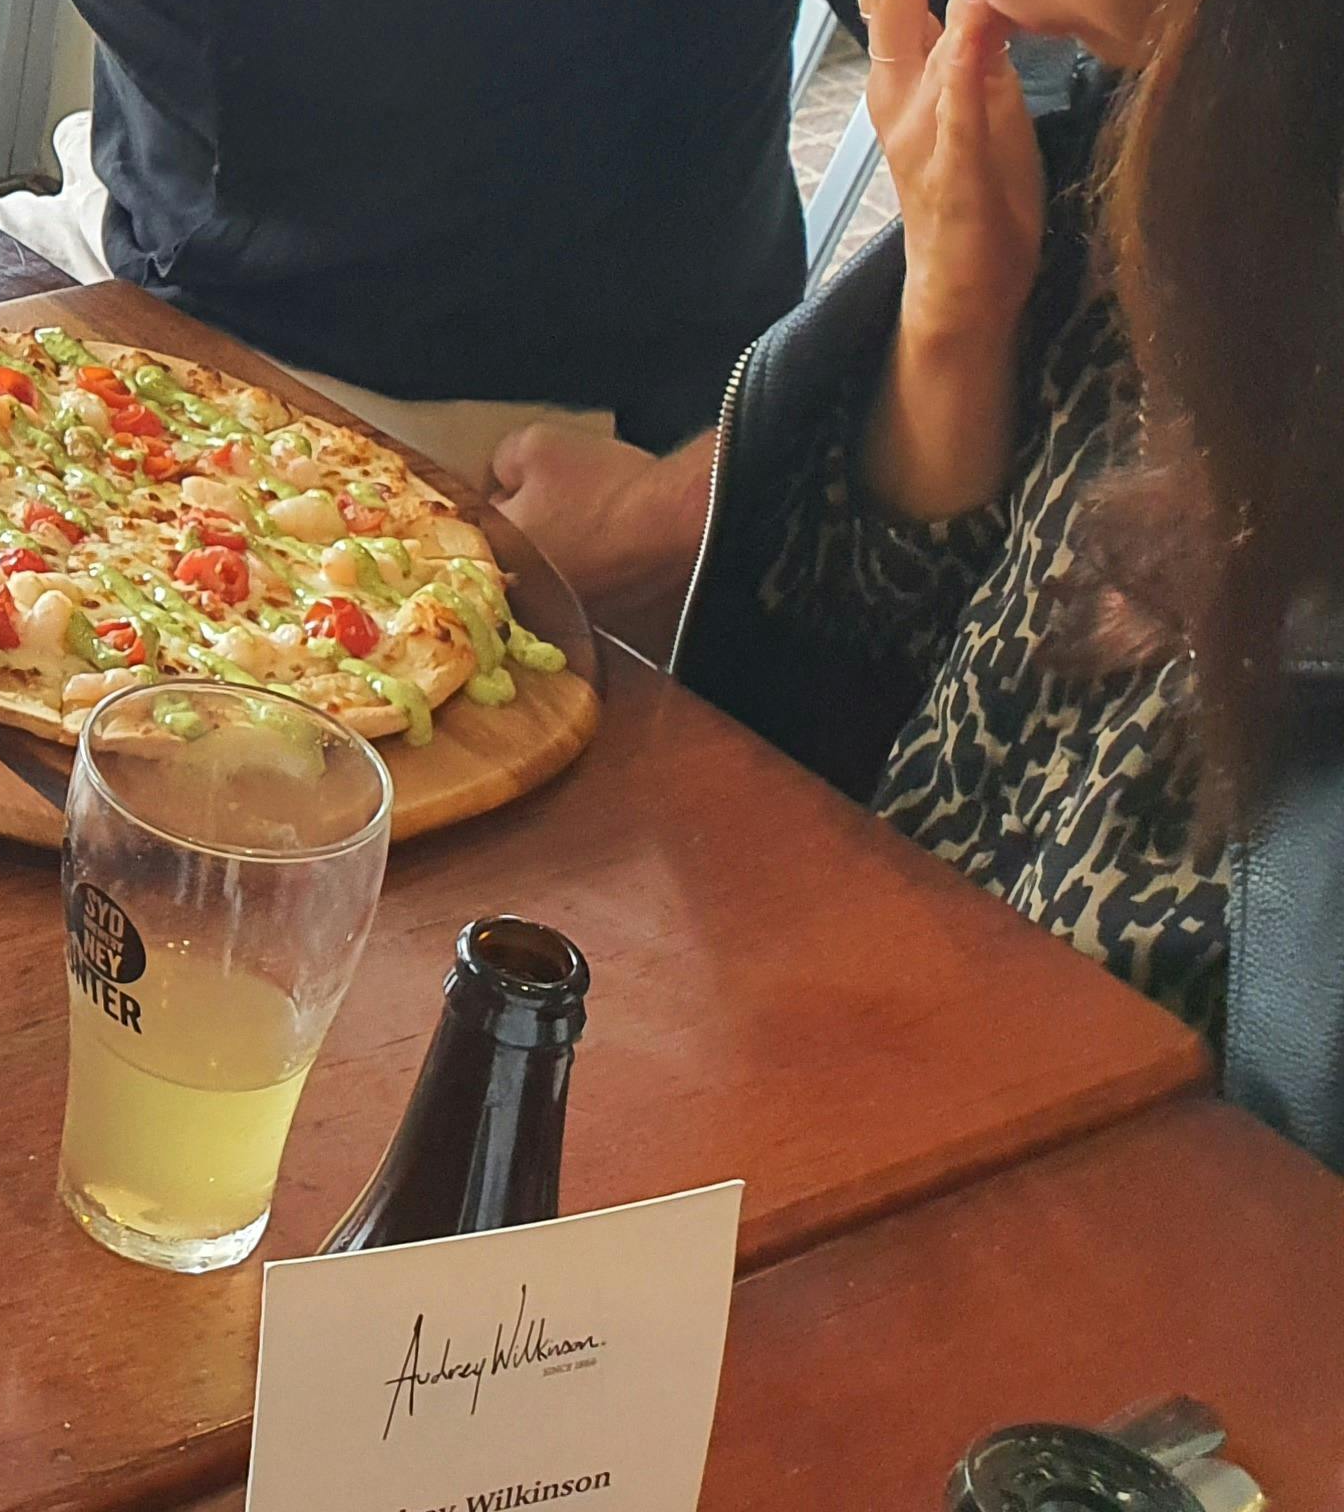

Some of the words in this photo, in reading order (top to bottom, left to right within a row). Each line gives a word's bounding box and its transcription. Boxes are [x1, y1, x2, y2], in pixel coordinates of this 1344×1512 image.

[84, 888, 124, 938] SYD
[383, 1313, 486, 1440] Audrey
[466, 1471, 611, 1512] Wilkinson
